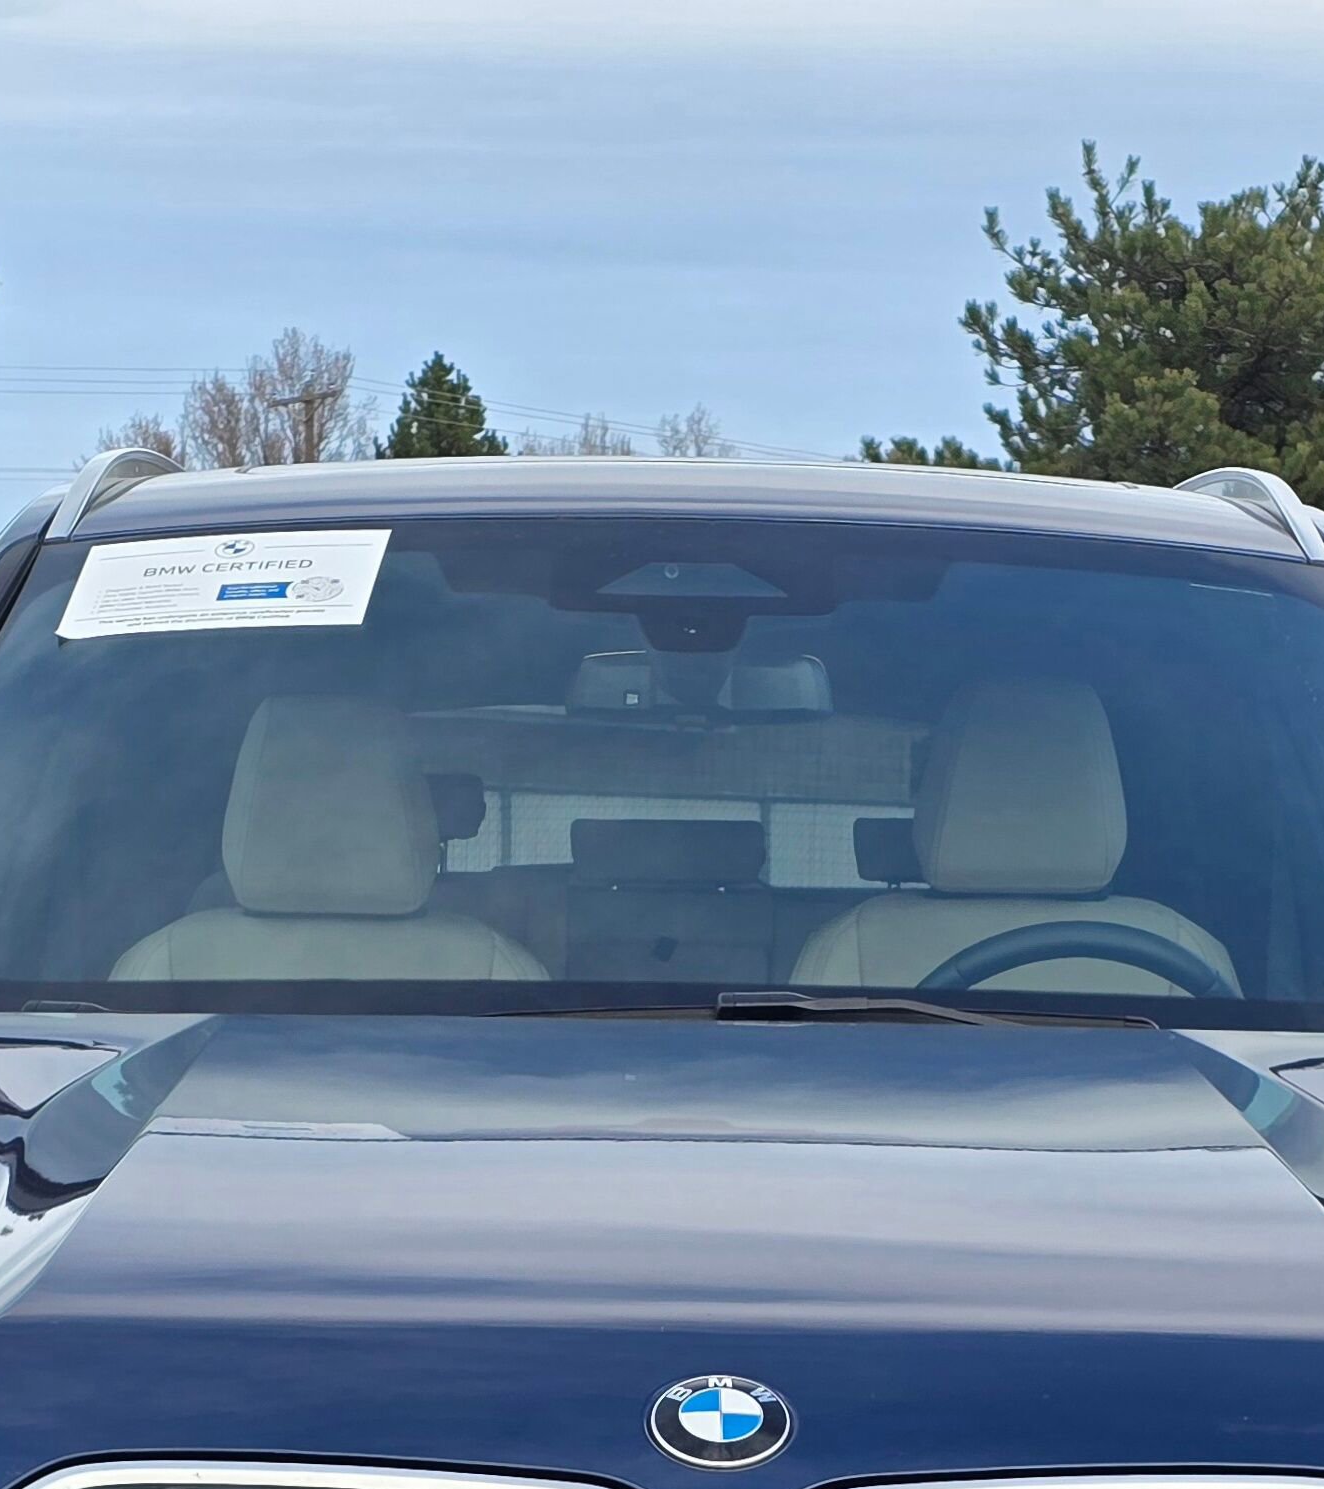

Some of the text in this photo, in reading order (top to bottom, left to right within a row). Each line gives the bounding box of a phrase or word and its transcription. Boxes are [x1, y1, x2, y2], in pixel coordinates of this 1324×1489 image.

[143, 559, 313, 578] BMW CERTIFIED
[666, 1377, 777, 1402] BMW
